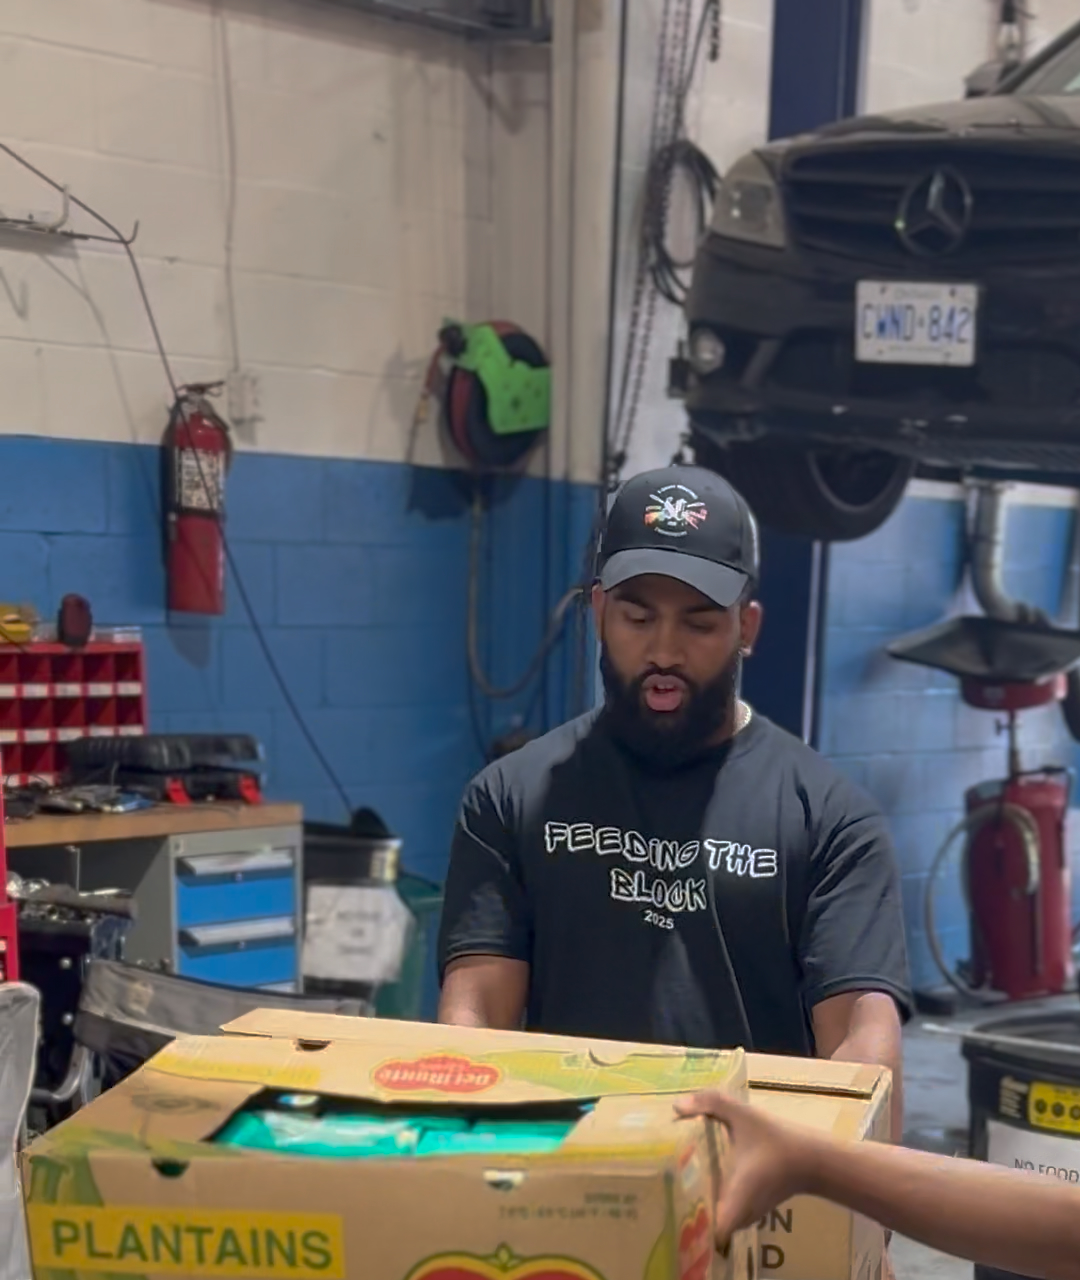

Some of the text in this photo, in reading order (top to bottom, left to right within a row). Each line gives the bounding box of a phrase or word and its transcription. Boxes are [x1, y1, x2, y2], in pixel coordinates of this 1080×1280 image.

[928, 303, 972, 344] 842
[704, 838, 778, 878] THE
[644, 910, 675, 930] 2025
[52, 1220, 333, 1270] PLANTAINS
